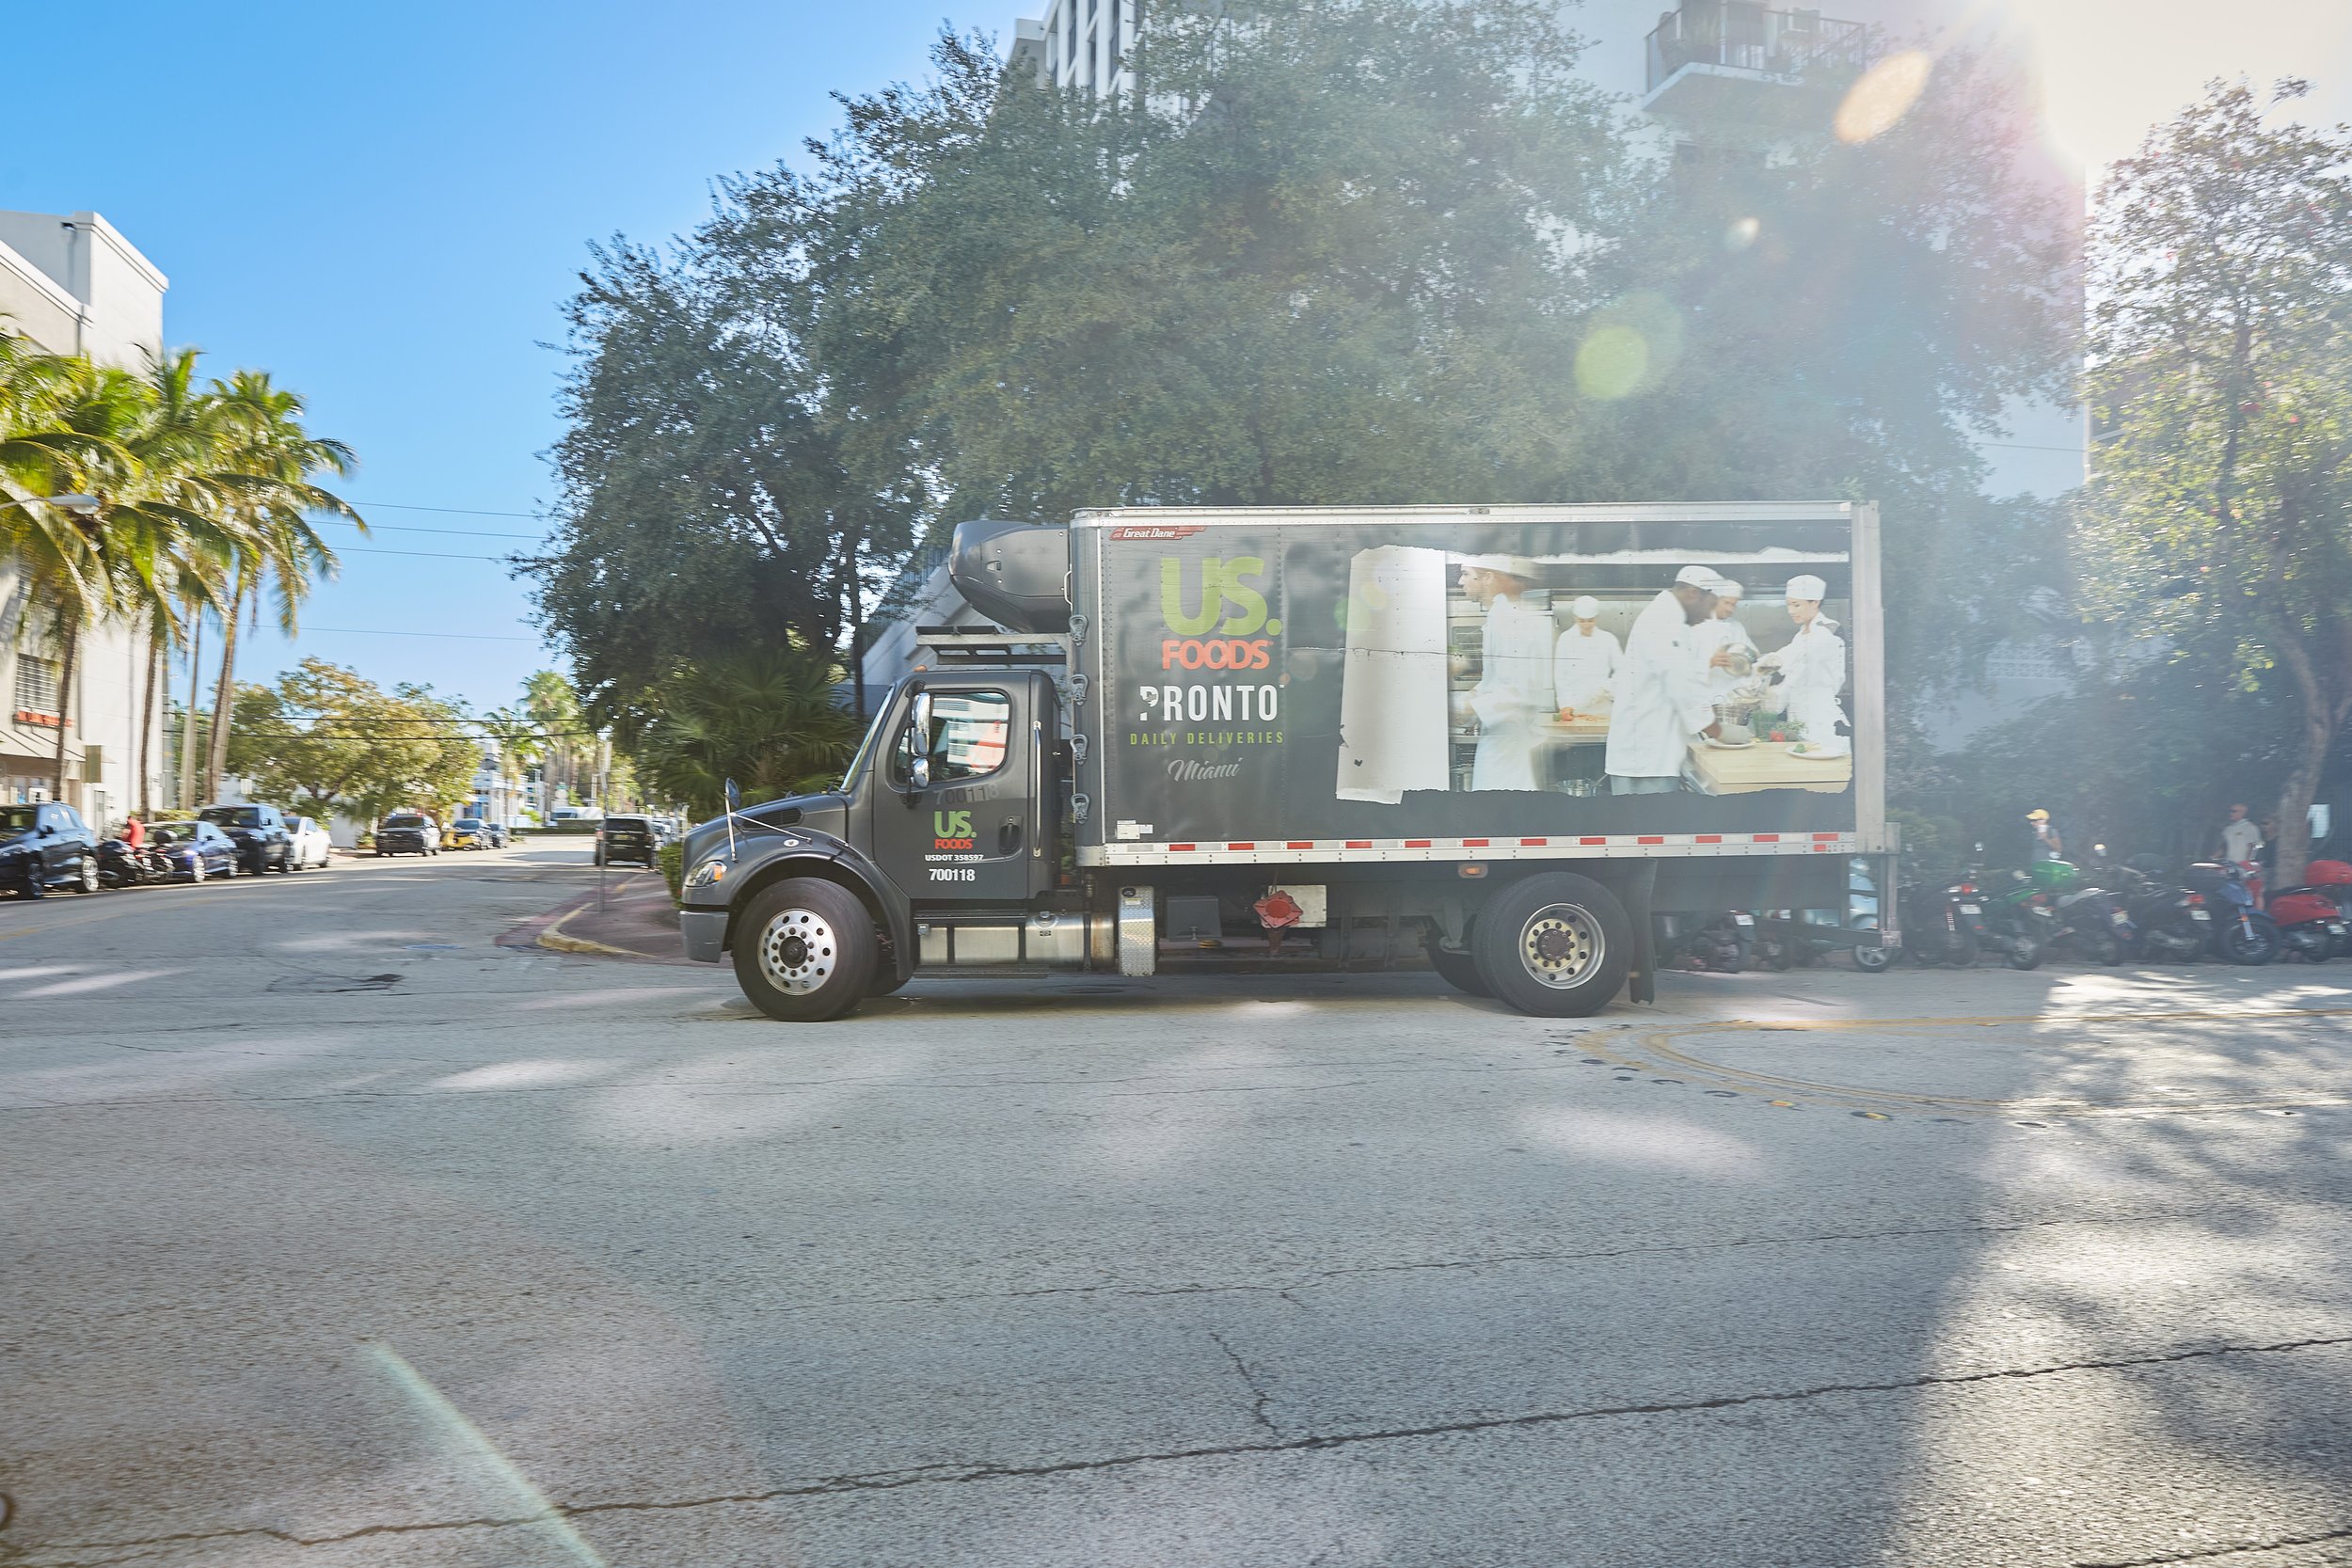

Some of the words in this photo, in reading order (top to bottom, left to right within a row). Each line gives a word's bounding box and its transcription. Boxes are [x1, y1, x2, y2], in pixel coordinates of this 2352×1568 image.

[1122, 528, 1151, 538] Great
[1151, 528, 1175, 538] Dane
[1160, 556, 1282, 637] US.
[1162, 639, 1270, 670] FOODS
[1130, 733, 1178, 745] DAILY
[1187, 732, 1284, 745] DELIVERIES
[1167, 756, 1244, 783] Miami
[933, 810, 977, 839] US.
[934, 839, 974, 849] FOODS
[929, 868, 976, 882] 700118
